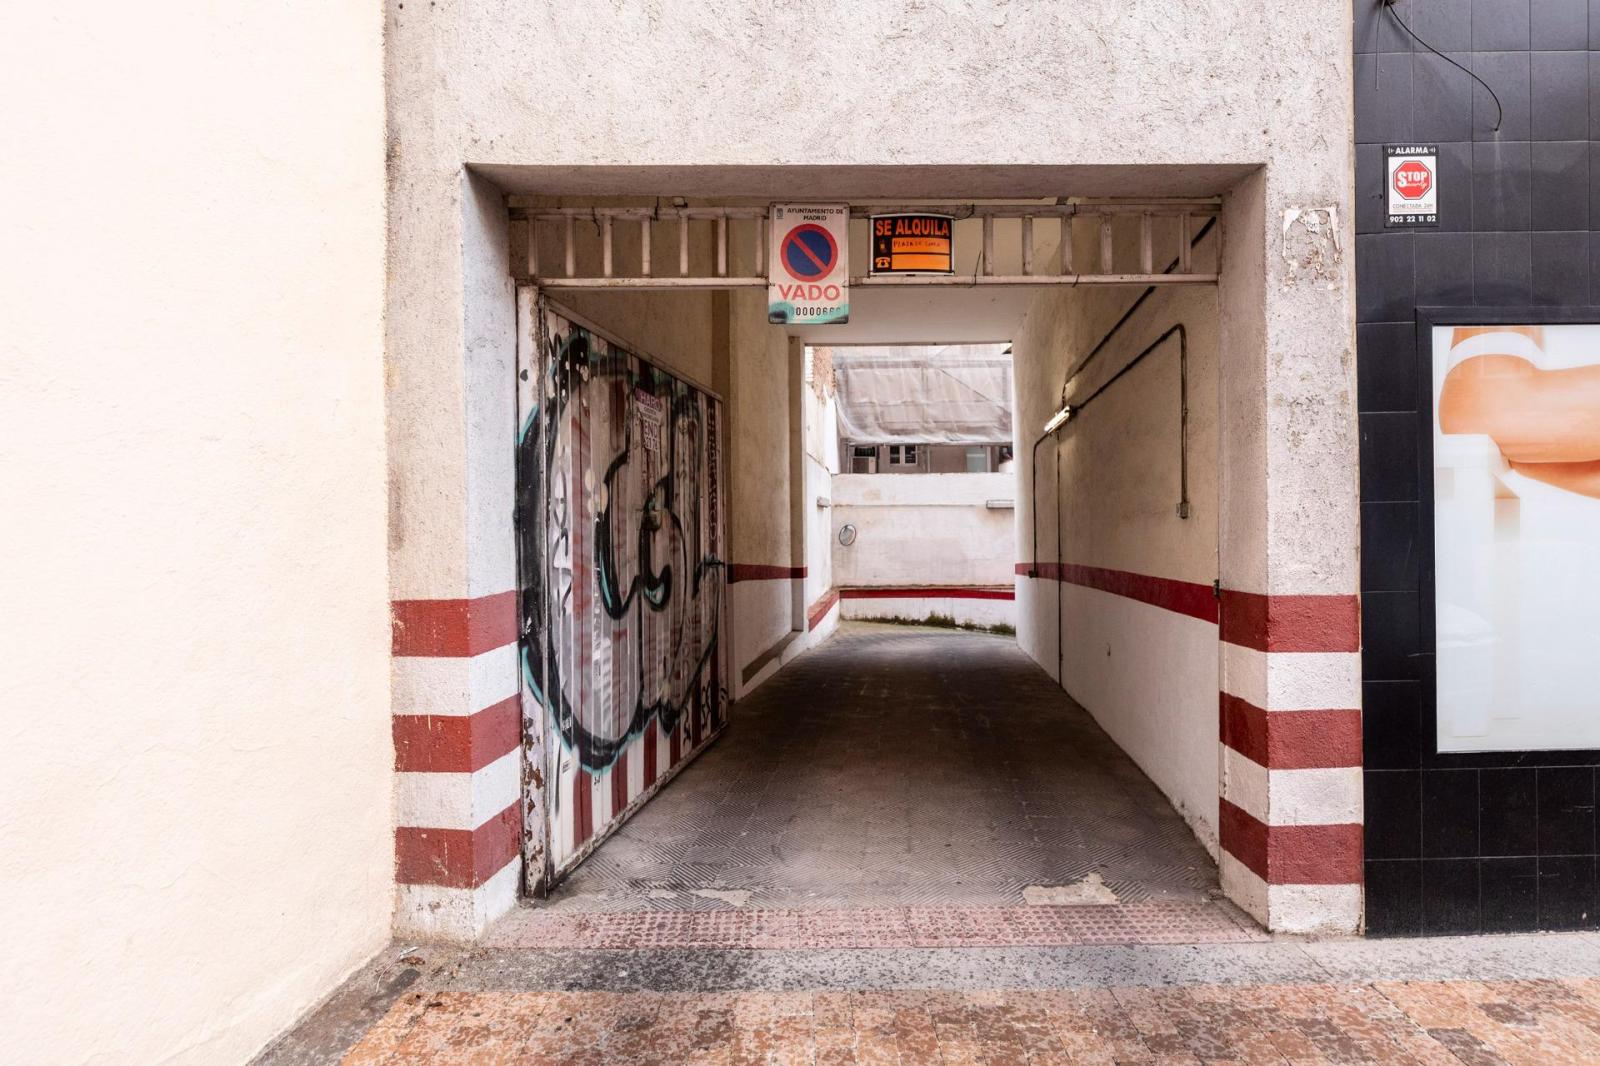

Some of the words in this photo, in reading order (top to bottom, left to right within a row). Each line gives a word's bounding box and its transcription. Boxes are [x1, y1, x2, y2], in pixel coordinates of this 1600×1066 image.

[1395, 147, 1429, 155] ALARMA
[1397, 171, 1428, 188] STOP
[876, 220, 892, 236] SE
[895, 219, 949, 236] ALQUILA
[1389, 215, 1404, 223] 902
[778, 284, 840, 301] VADO
